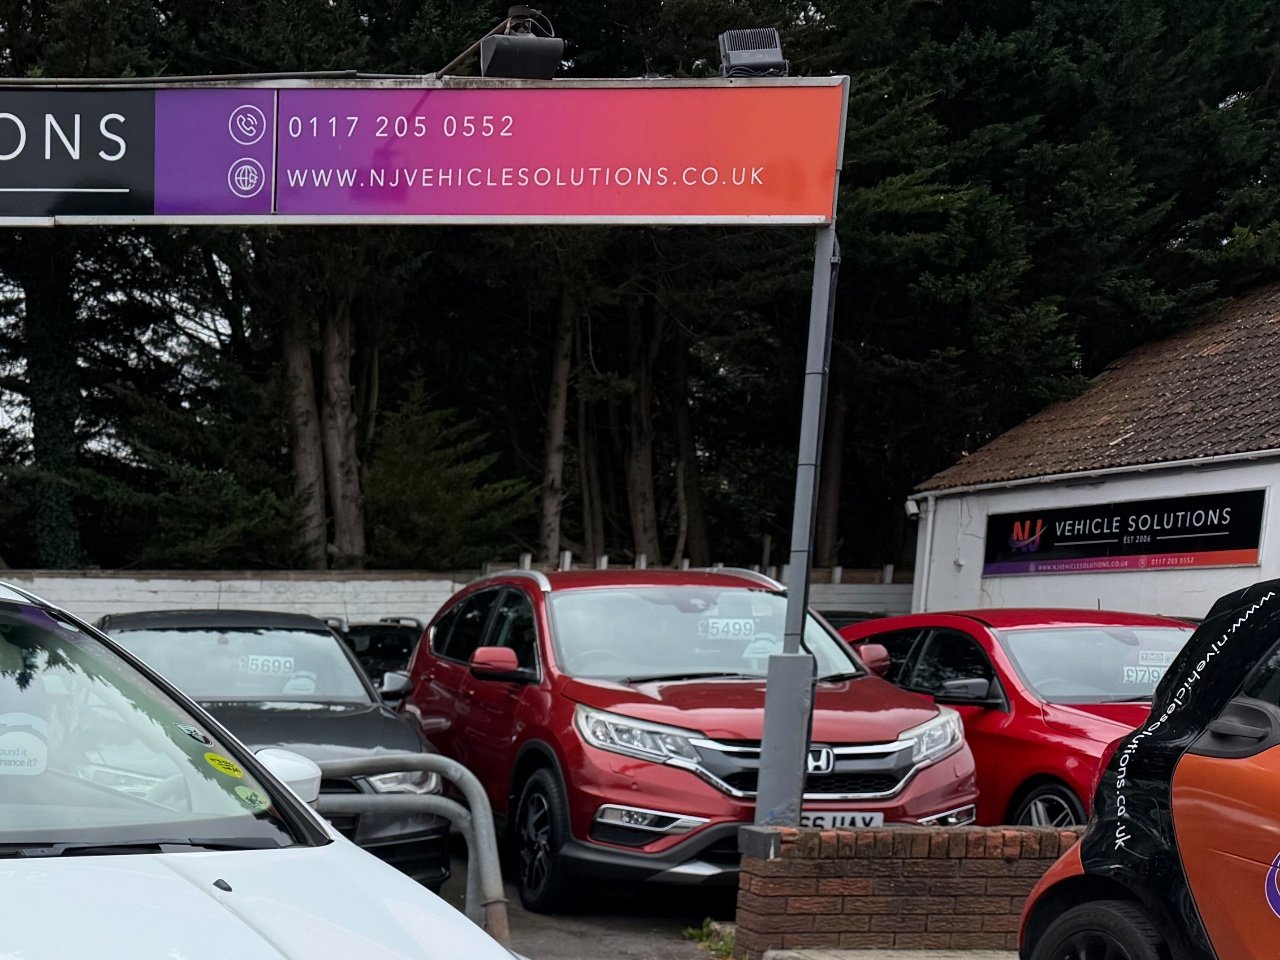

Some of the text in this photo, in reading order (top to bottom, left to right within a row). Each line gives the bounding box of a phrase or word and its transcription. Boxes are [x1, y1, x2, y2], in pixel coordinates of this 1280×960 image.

[289, 114, 515, 138] 0117 205 0552
[287, 166, 765, 188] WWW.NJVEHICLESOLUTIONS.CO.UK
[1011, 507, 1232, 552] NJ VEHICLE SOLUTIONS
[1123, 534, 1152, 544] EST 2006
[1125, 668, 1167, 684] £79
